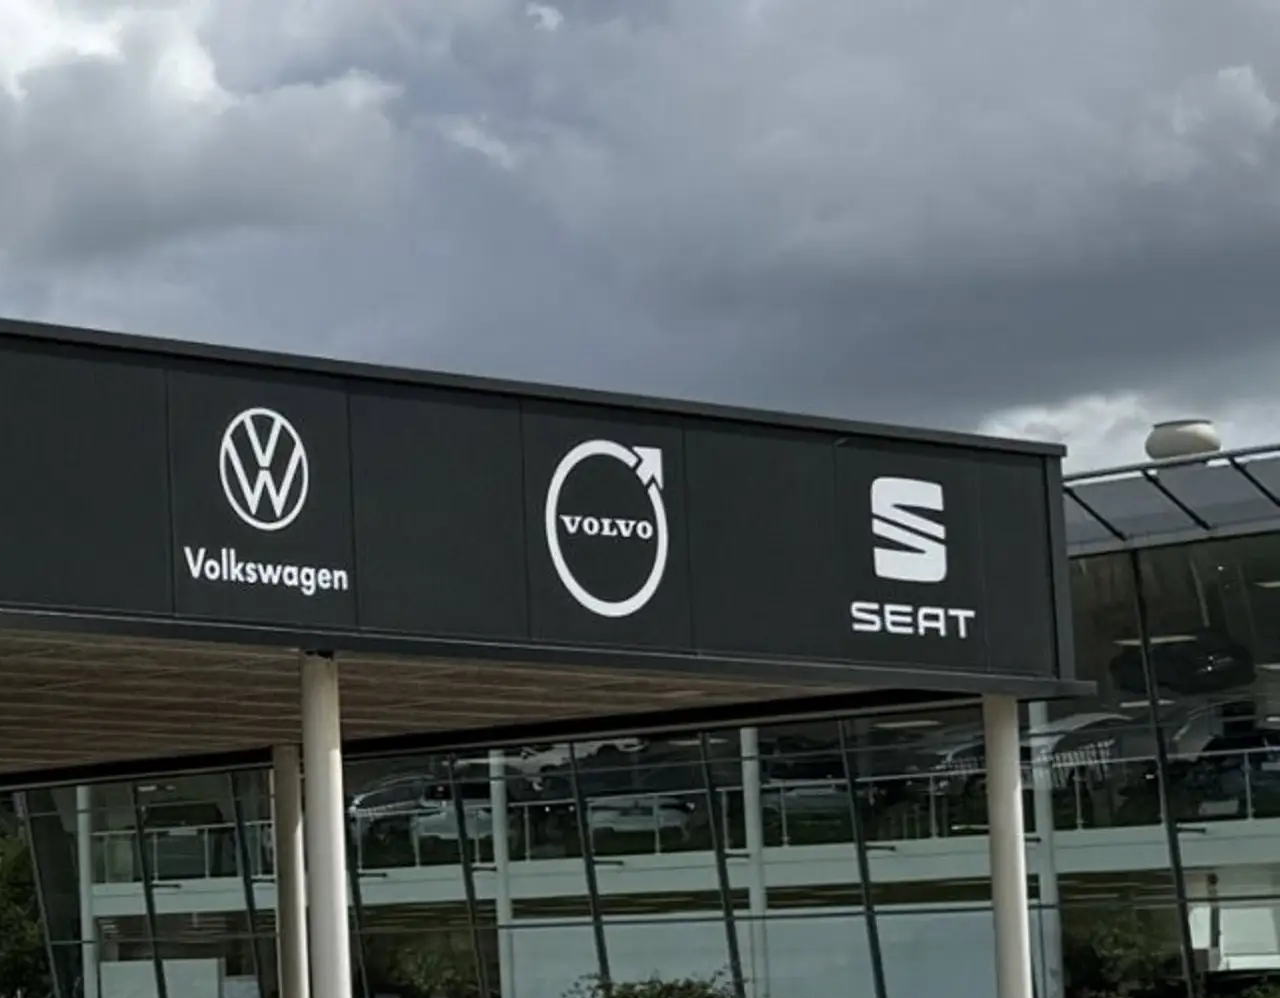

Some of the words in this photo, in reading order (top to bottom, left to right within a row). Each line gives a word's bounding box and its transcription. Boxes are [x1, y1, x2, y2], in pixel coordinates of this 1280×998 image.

[559, 514, 653, 540] VOLVO
[183, 546, 349, 596] Volkswagen
[850, 600, 976, 639] SEAT
